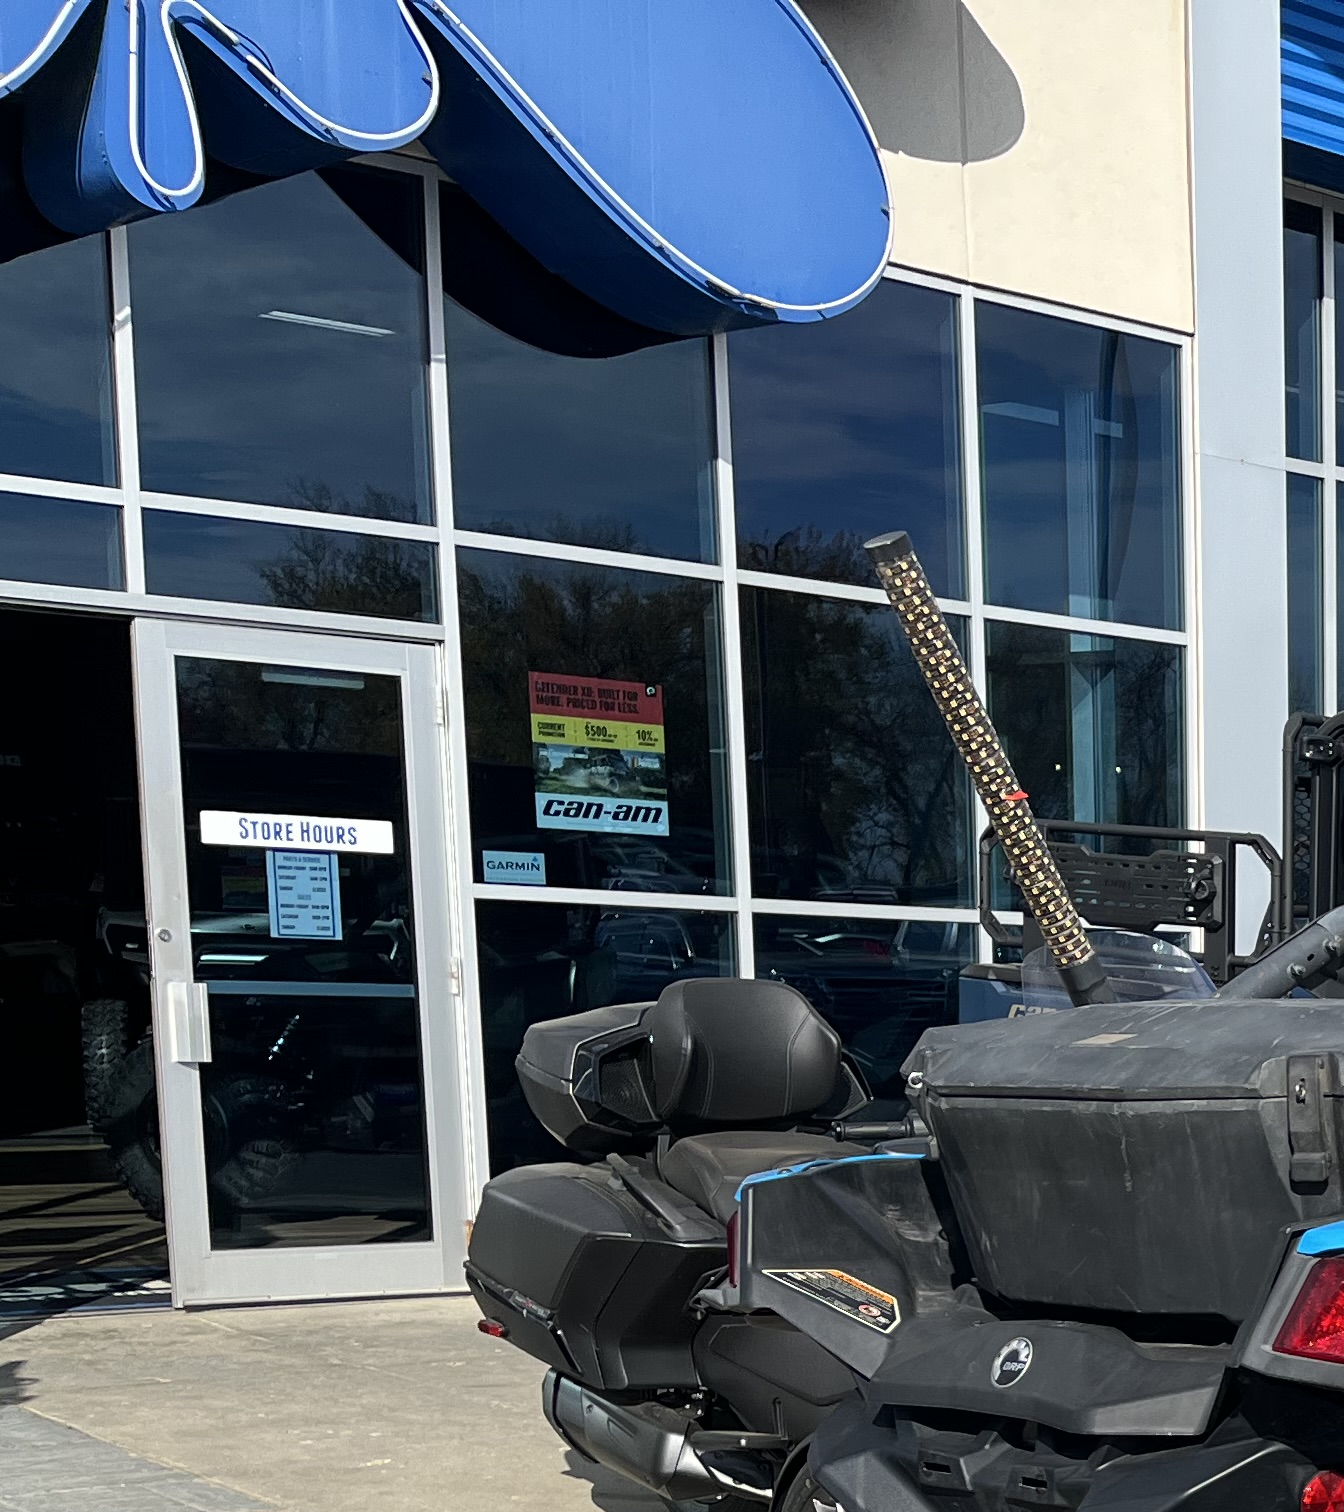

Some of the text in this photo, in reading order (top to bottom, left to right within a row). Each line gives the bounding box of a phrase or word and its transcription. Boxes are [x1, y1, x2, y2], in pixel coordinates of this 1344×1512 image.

[622, 690, 639, 702] FOR
[566, 697, 597, 710] PRICED
[599, 701, 616, 713] FOR
[584, 723, 607, 737] $500
[635, 729, 653, 742] 10%
[542, 799, 663, 824] can-am
[238, 817, 358, 846] STORE HOURS
[486, 860, 541, 872] GARMIN
